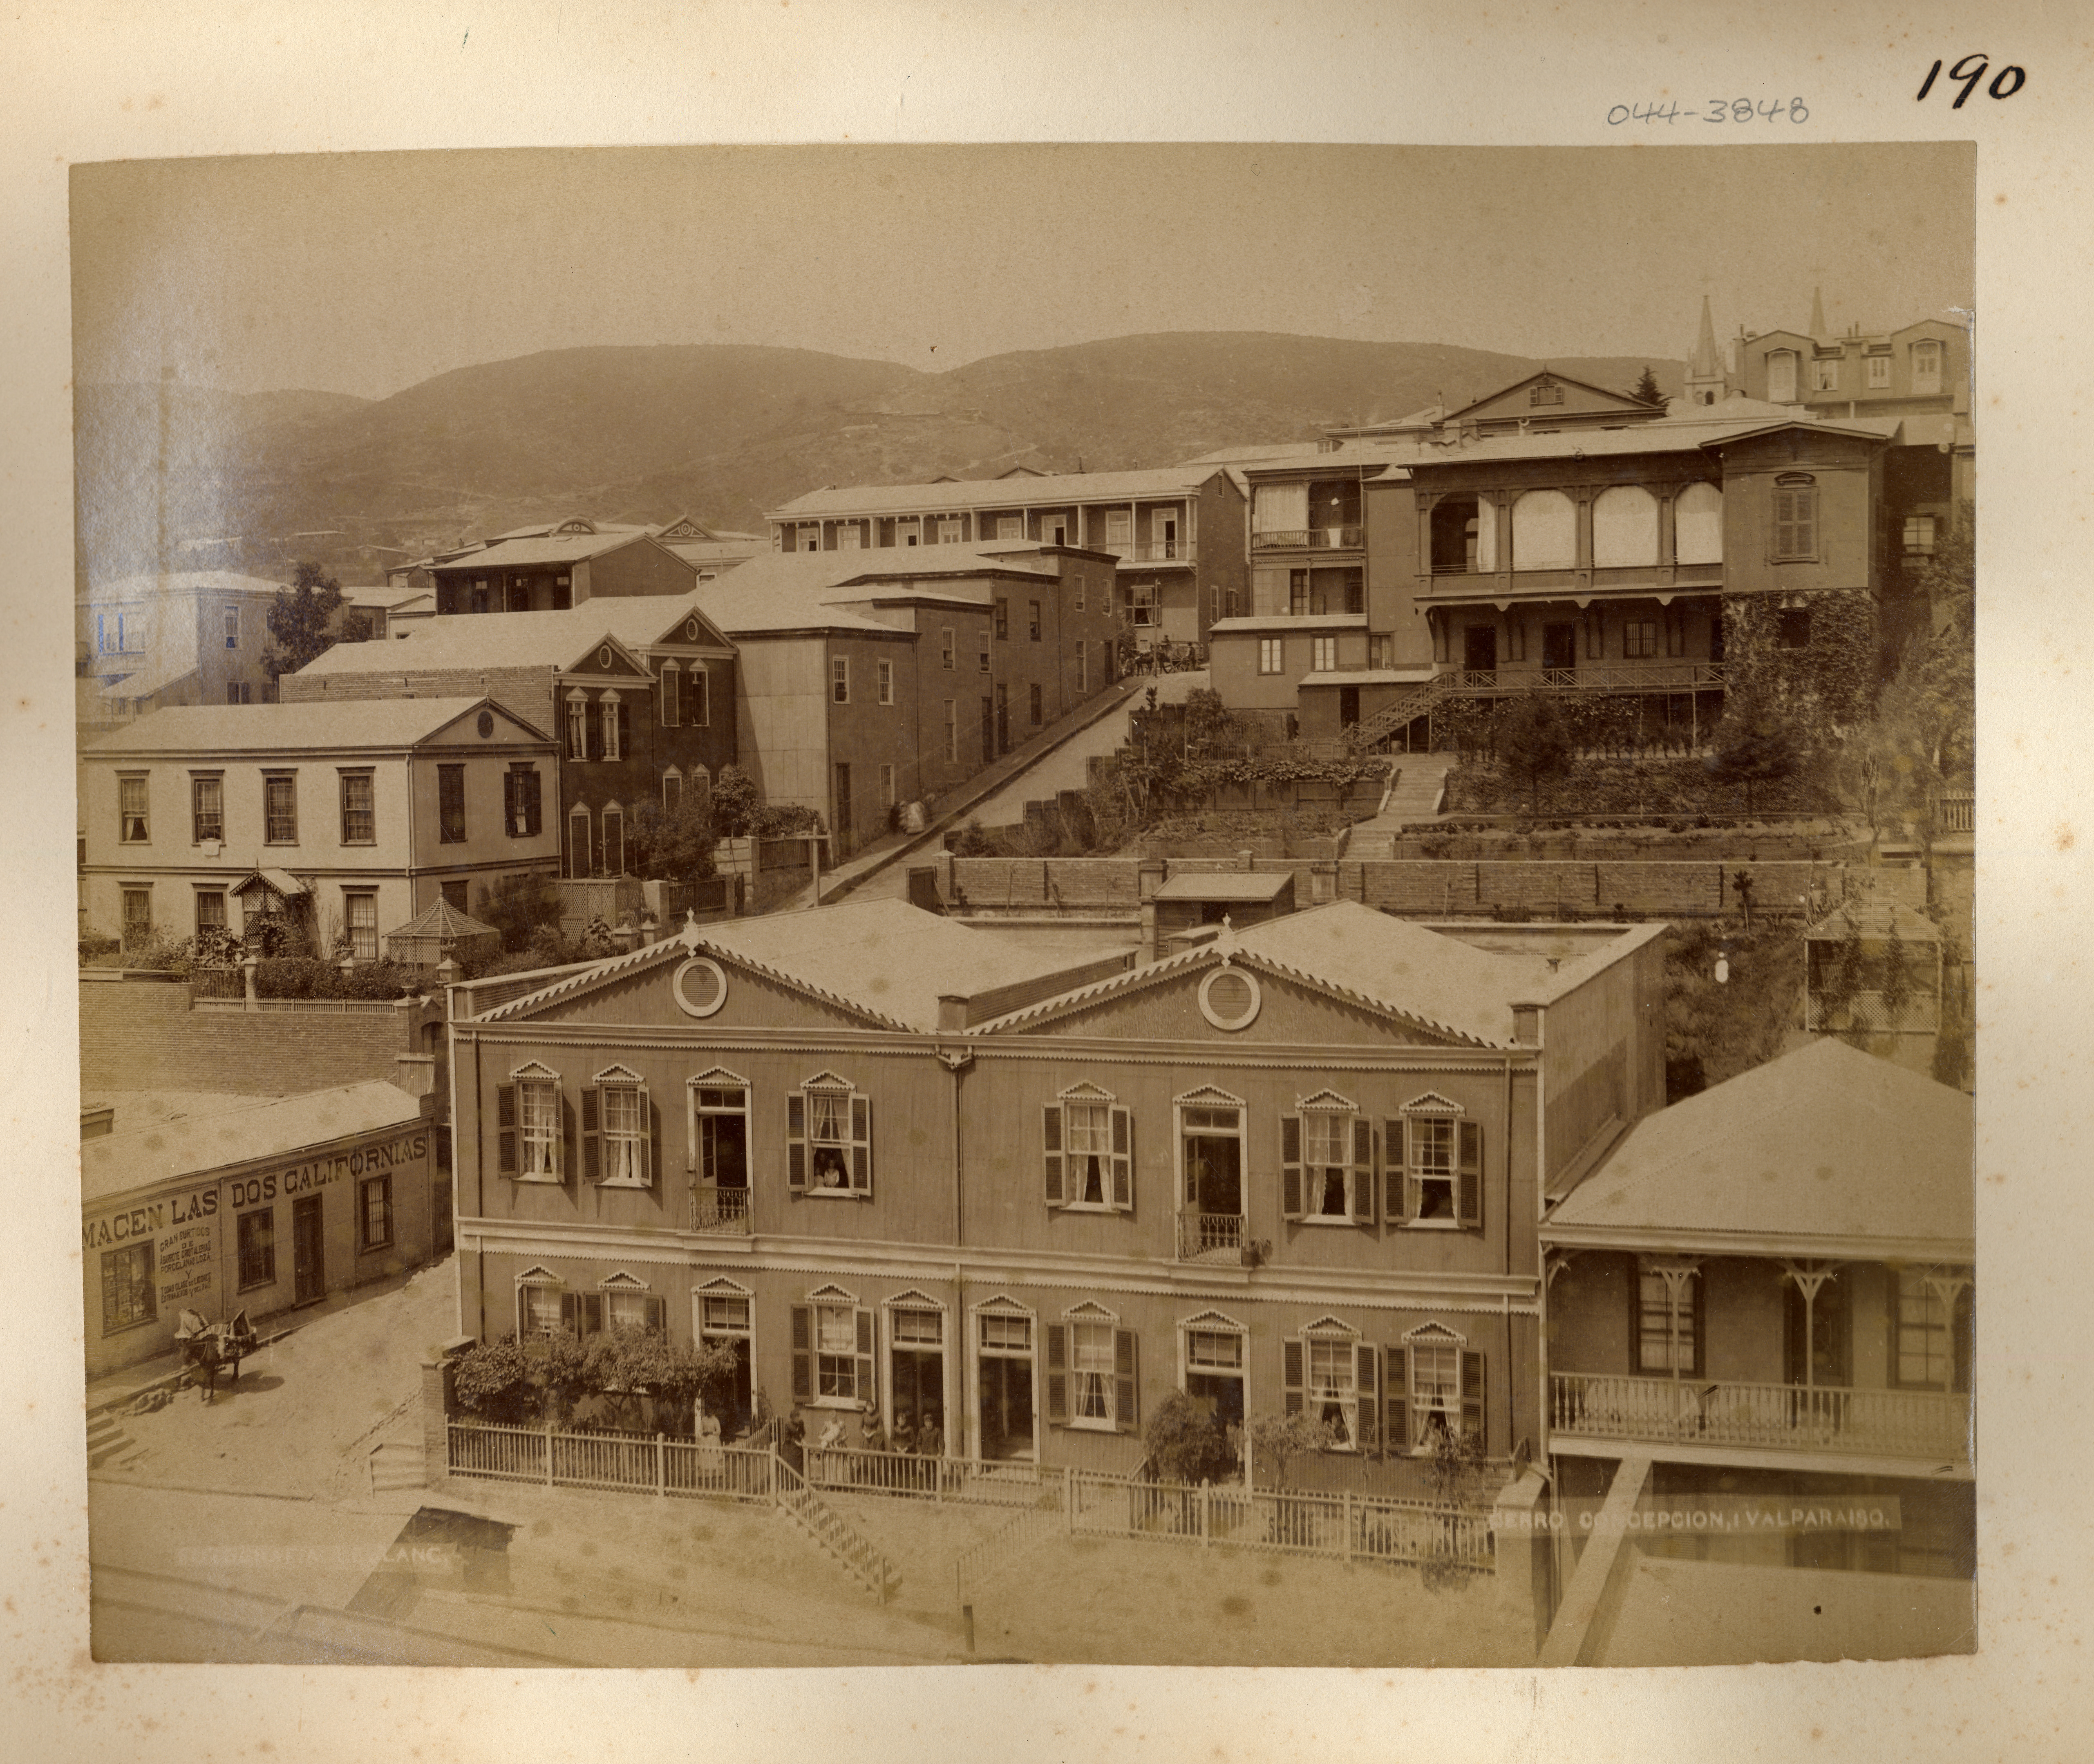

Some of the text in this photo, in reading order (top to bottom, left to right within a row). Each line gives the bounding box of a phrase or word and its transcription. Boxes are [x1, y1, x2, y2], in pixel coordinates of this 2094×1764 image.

[1917, 54, 2025, 109] 190
[1607, 96, 1809, 125] 044-3848
[171, 1189, 219, 1225] LAS
[232, 1175, 277, 1209] DOS
[284, 1136, 427, 1195] CALIFORNIAS
[160, 1233, 178, 1252] GRAN
[181, 1240, 194, 1249] DE
[196, 1252, 211, 1264] LOZA
[185, 1269, 192, 1279] Y
